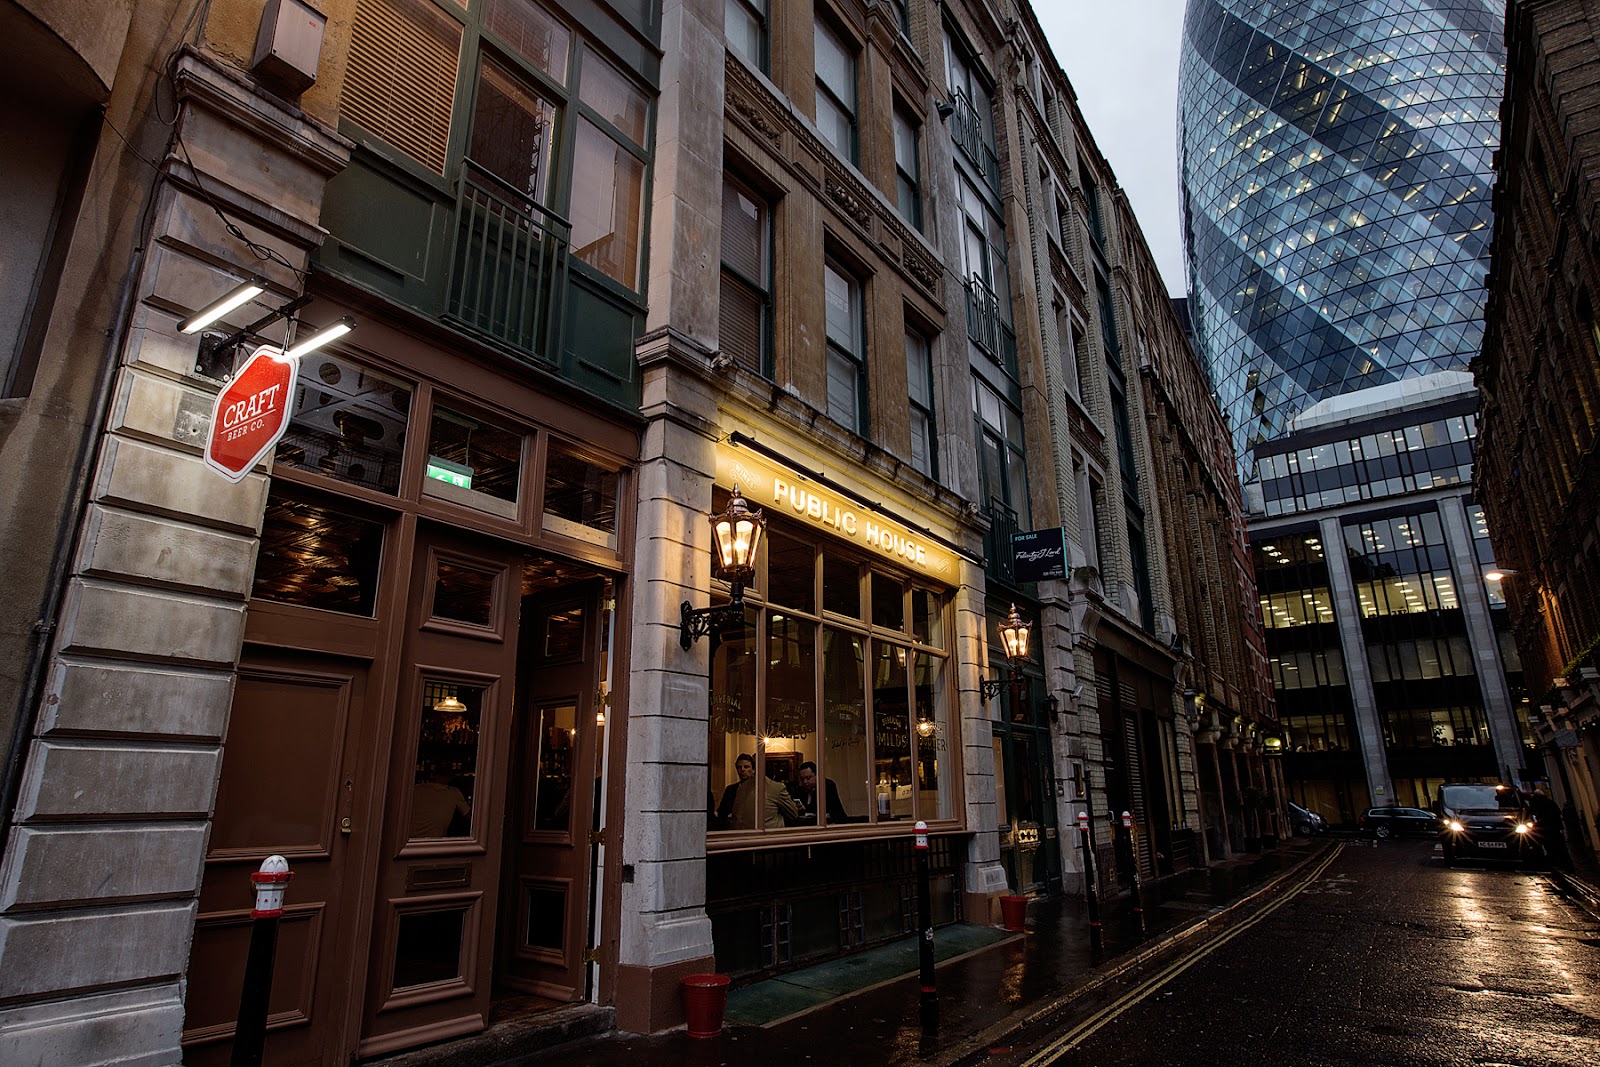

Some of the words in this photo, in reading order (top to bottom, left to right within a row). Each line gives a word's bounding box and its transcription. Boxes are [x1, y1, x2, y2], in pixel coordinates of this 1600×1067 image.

[223, 383, 280, 428] CRAFT
[227, 425, 248, 442] BEER
[250, 418, 265, 432] CO.
[773, 477, 857, 536] PUBLIC
[865, 521, 927, 568] HOUSE
[709, 716, 751, 735] TOUTS
